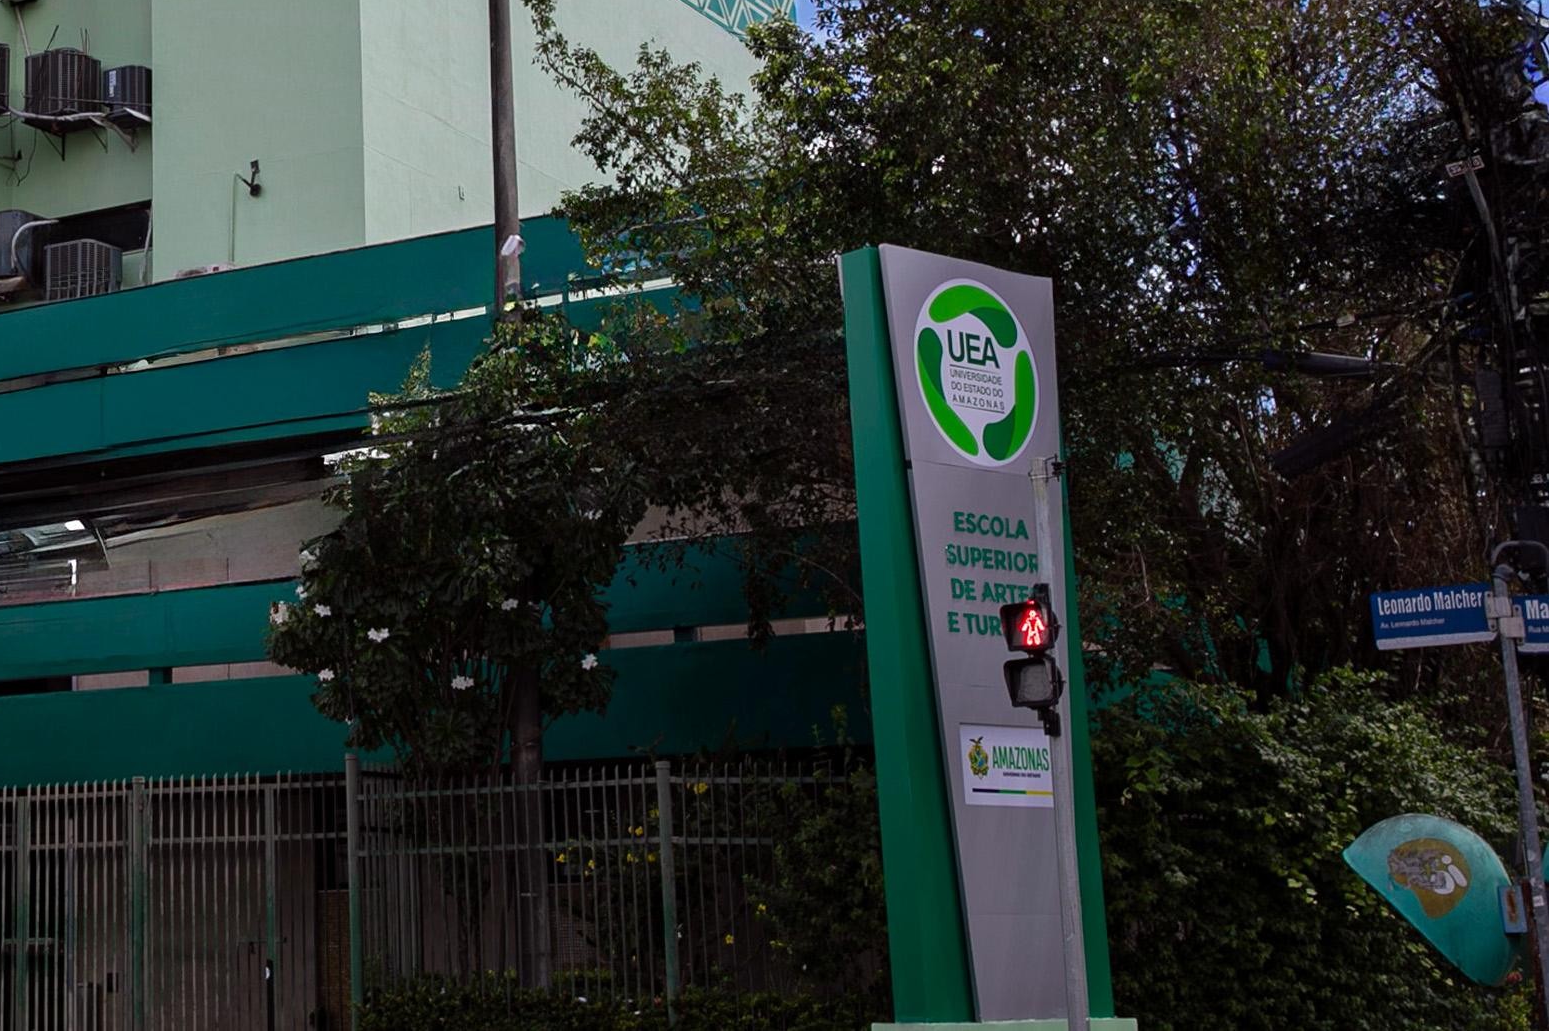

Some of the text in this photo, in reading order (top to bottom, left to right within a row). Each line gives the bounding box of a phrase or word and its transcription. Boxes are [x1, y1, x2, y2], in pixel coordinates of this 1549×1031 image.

[947, 329, 1000, 369] UEA
[950, 369, 1003, 386] UNIVERSIDADE
[951, 381, 1003, 398] DO ESTADO DO
[952, 394, 1005, 410] AMAZONAS
[953, 511, 1029, 540] ESCOLA
[947, 543, 1038, 574] SUPERIOR
[951, 577, 1035, 603] DE ARTE
[1377, 589, 1482, 616] Leonardo Malcher
[947, 611, 960, 633] E
[992, 745, 1050, 771] AMAZONAS
